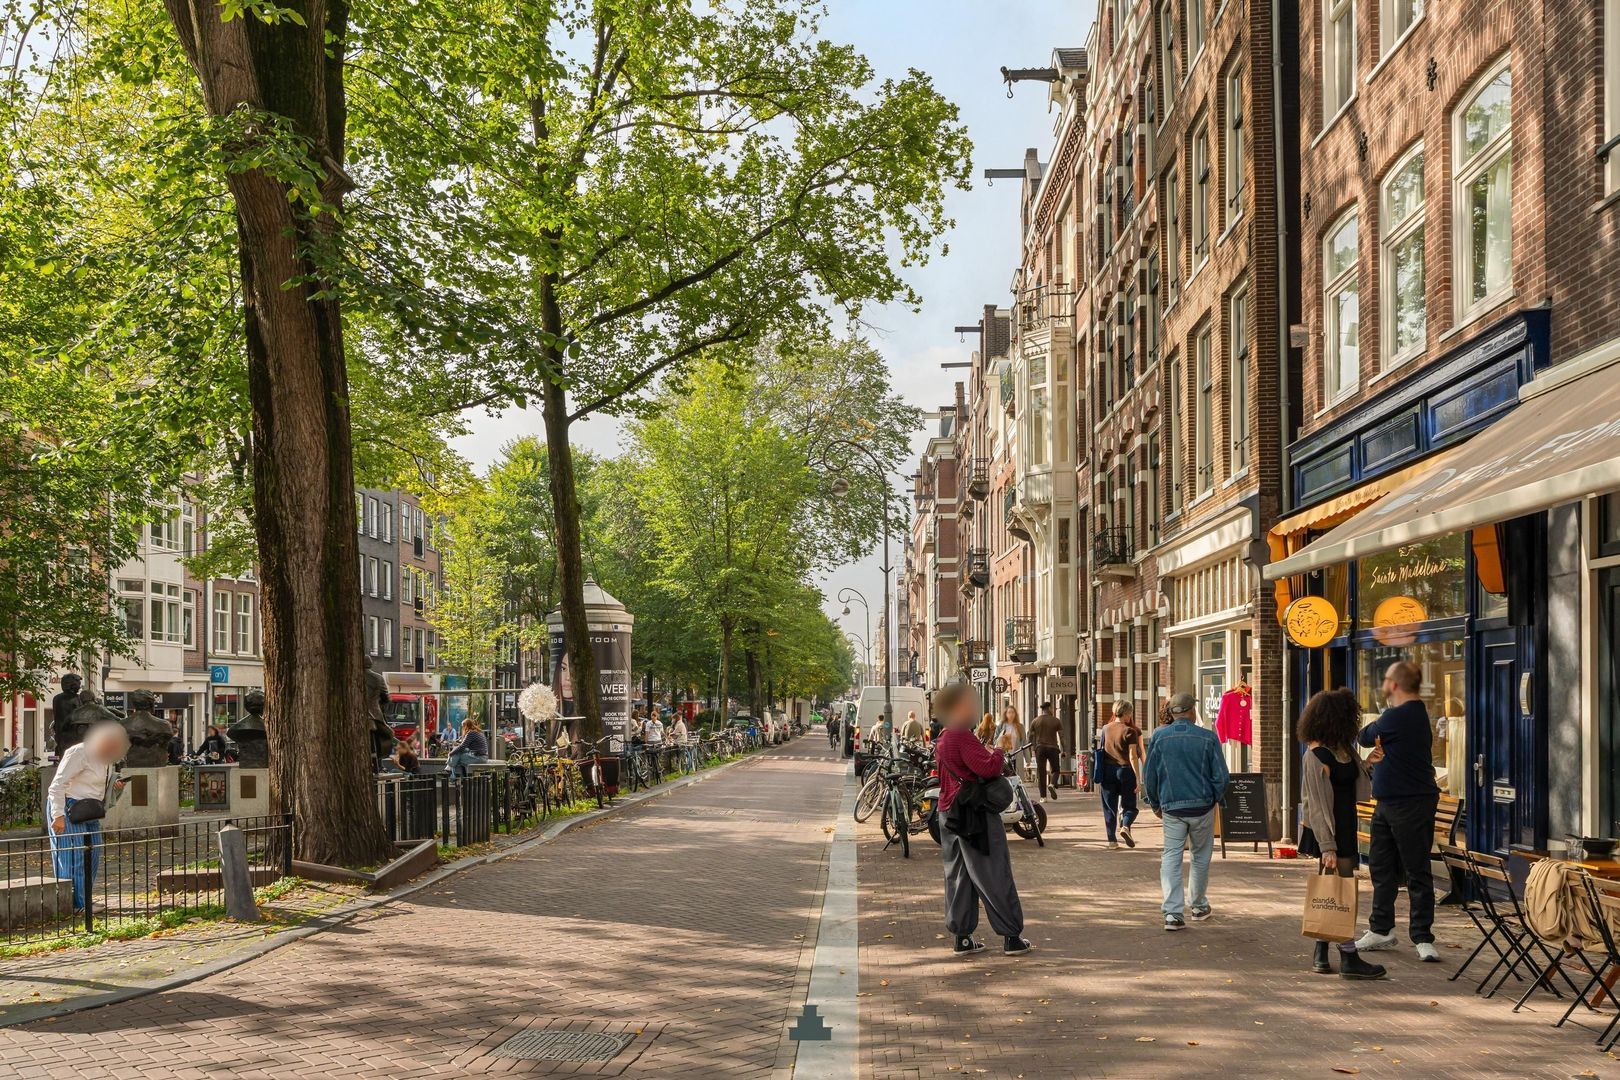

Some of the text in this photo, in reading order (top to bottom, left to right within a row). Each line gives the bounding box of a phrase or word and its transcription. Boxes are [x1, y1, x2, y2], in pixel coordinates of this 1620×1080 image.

[1370, 555, 1447, 589] Sainte Madeleine
[973, 669, 987, 680] Etos
[600, 684, 628, 694] WEEK
